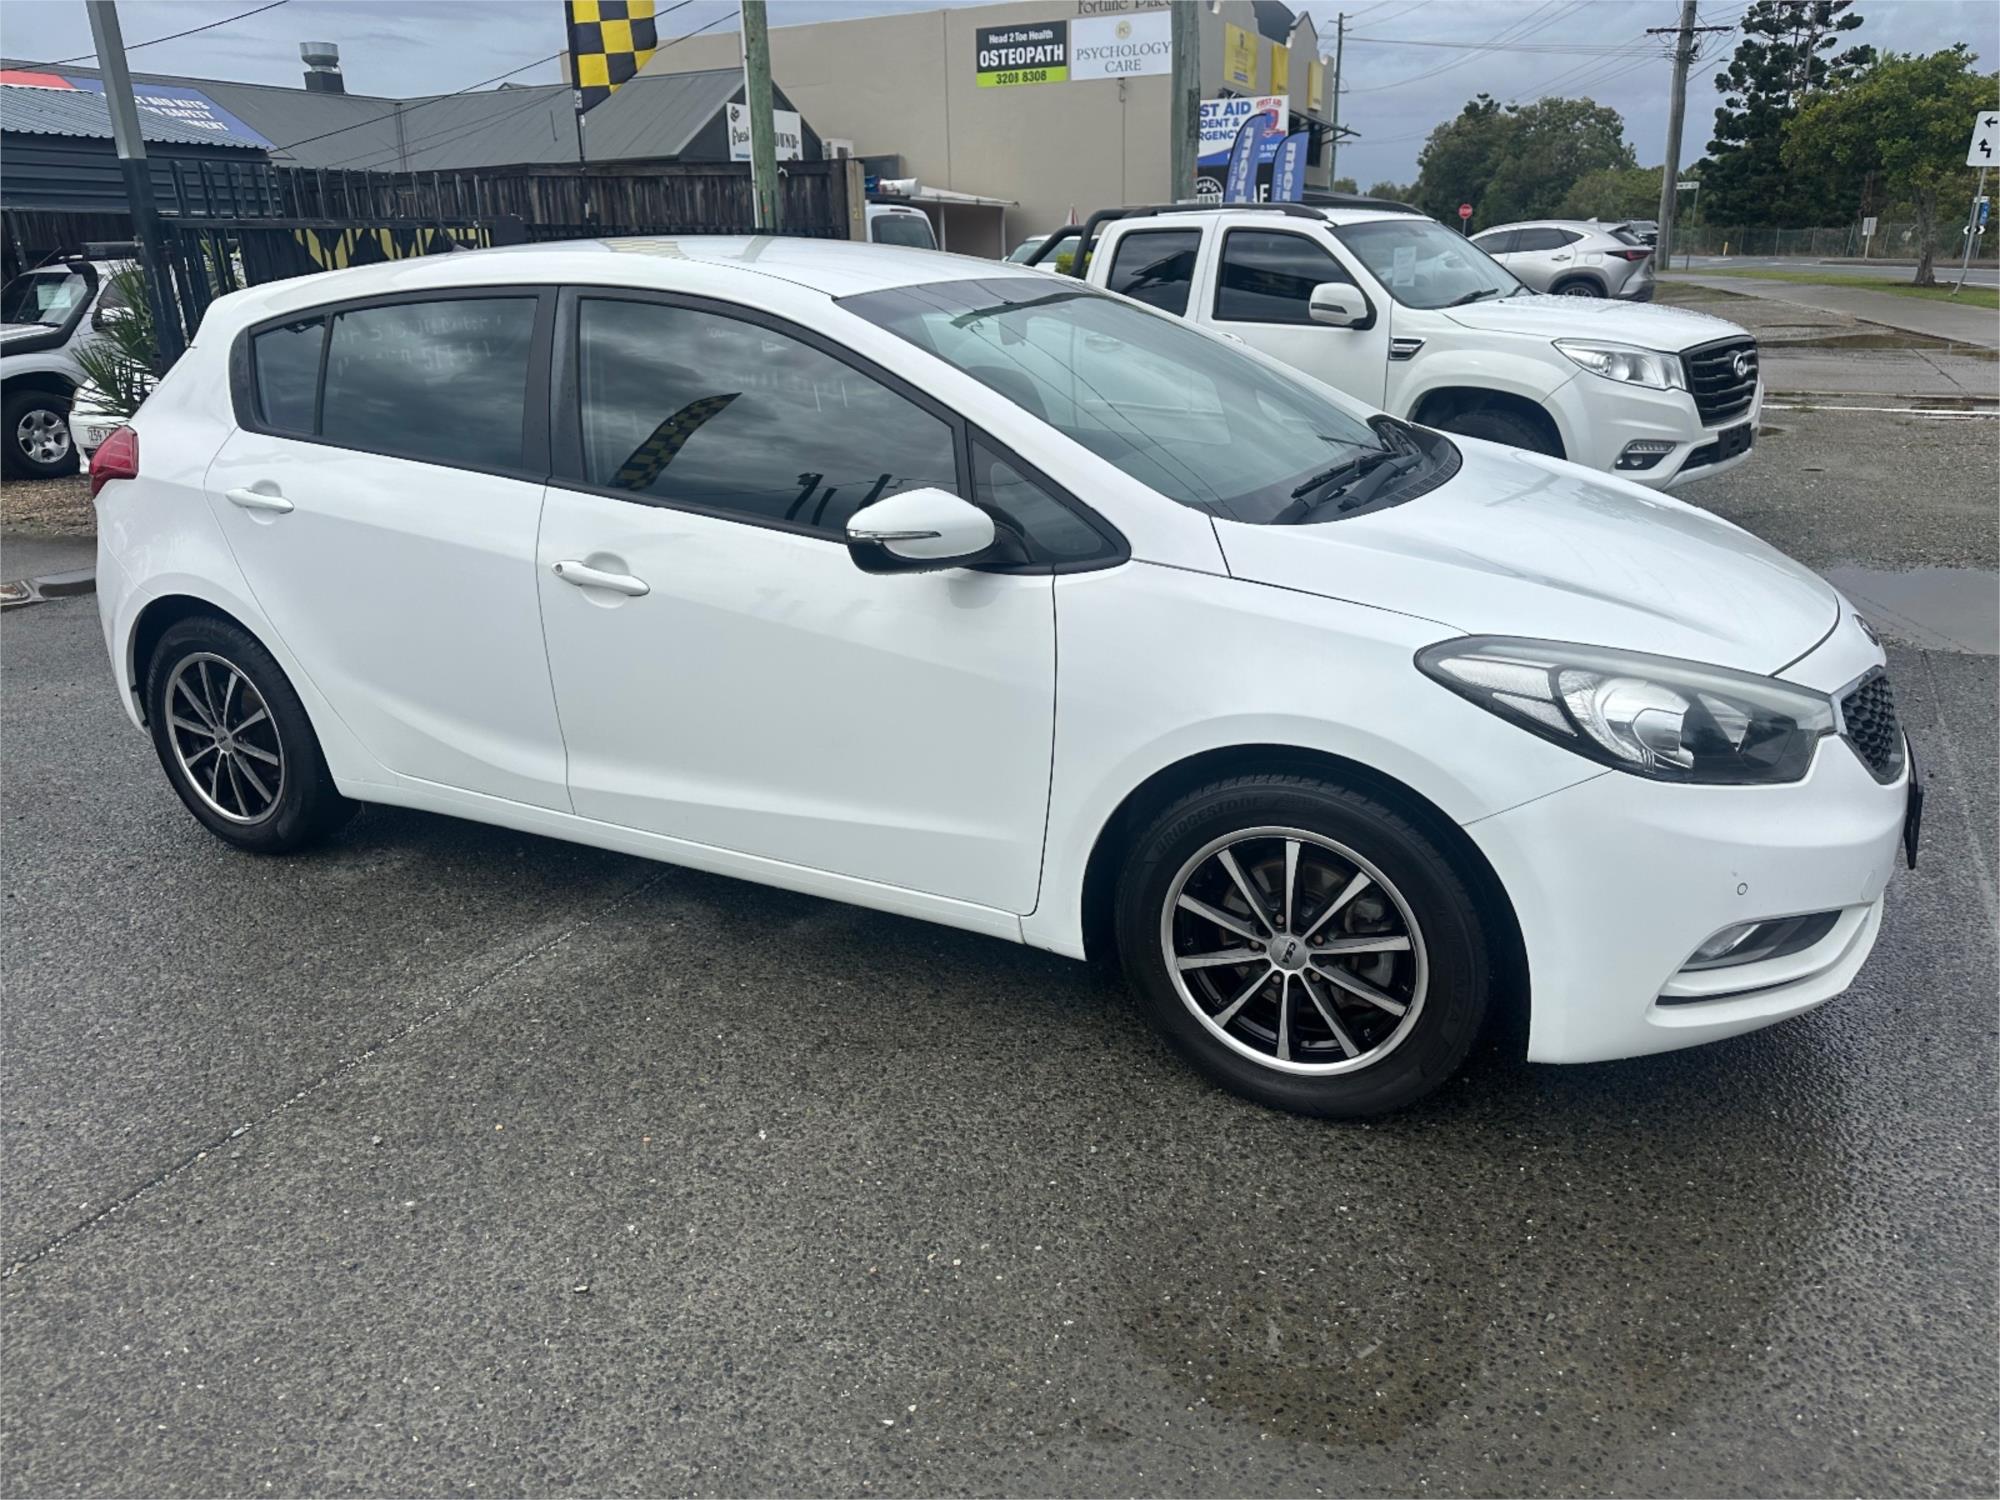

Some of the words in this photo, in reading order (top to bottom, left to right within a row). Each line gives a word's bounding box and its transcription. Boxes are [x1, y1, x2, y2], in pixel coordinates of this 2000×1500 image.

[988, 33, 1008, 44] Head
[1009, 32, 1014, 42] 2
[1015, 31, 1028, 41] Toe
[1029, 29, 1053, 40] Health
[980, 43, 1064, 67] OSTEOPATH
[1076, 41, 1172, 61] PSYCHOLOGY
[1105, 59, 1142, 73] CARE
[1223, 101, 1251, 116] AID
[1200, 119, 1230, 129] DENT
